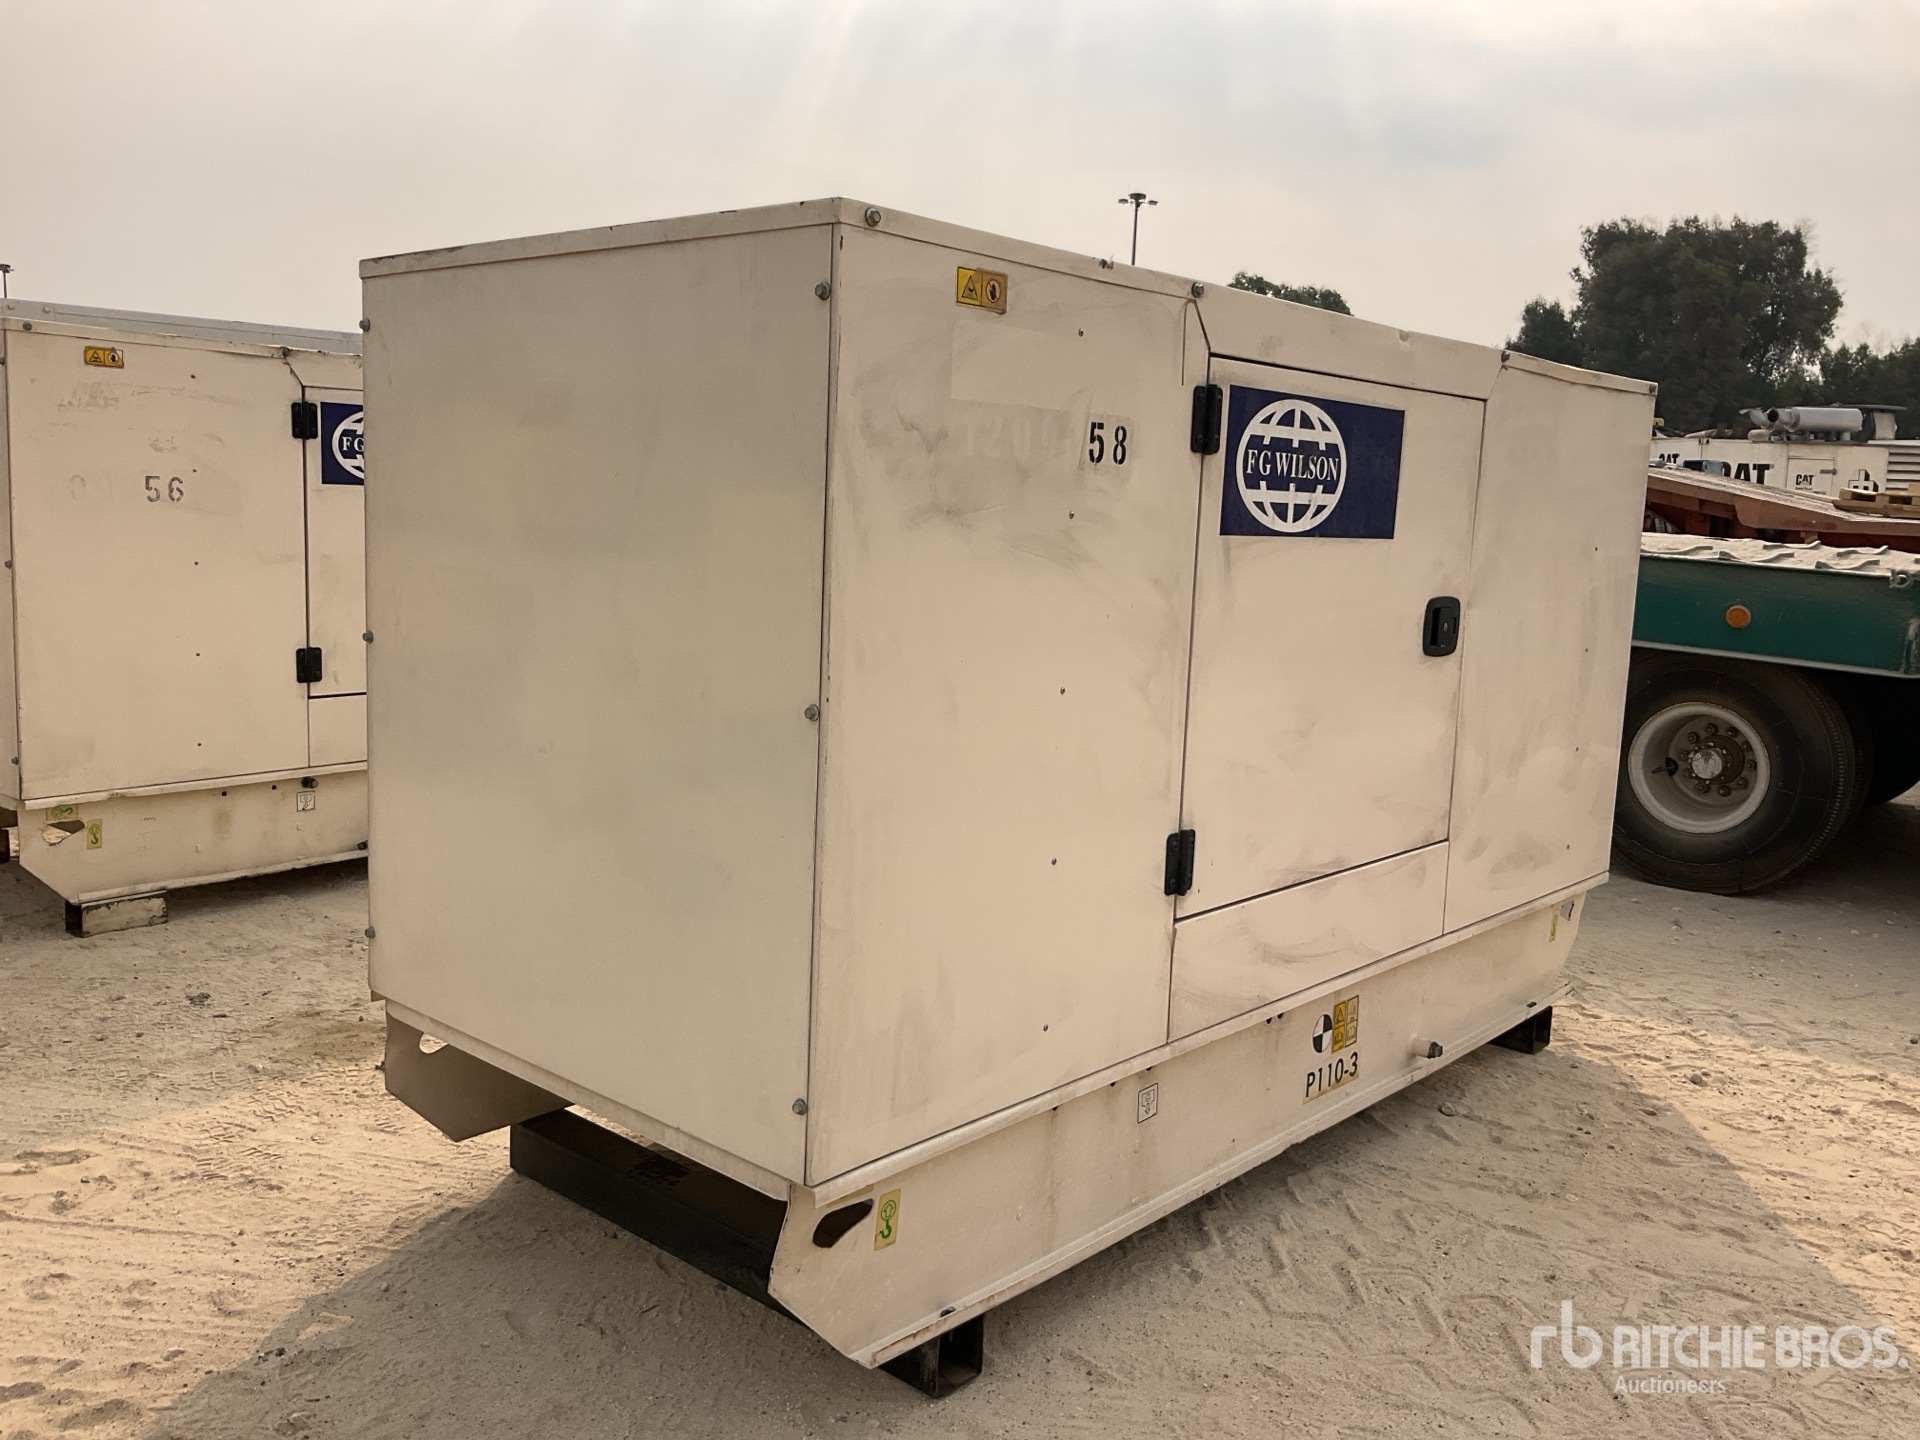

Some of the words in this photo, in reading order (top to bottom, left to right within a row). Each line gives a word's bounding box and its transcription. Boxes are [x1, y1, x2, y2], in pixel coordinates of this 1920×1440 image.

[342, 436, 365, 452] FG
[1089, 421, 1127, 465] 58
[1275, 452, 1339, 480] WILSON
[145, 475, 184, 502] 56
[1795, 474, 1814, 486] CAT
[1305, 1051, 1358, 1098] P110-3
